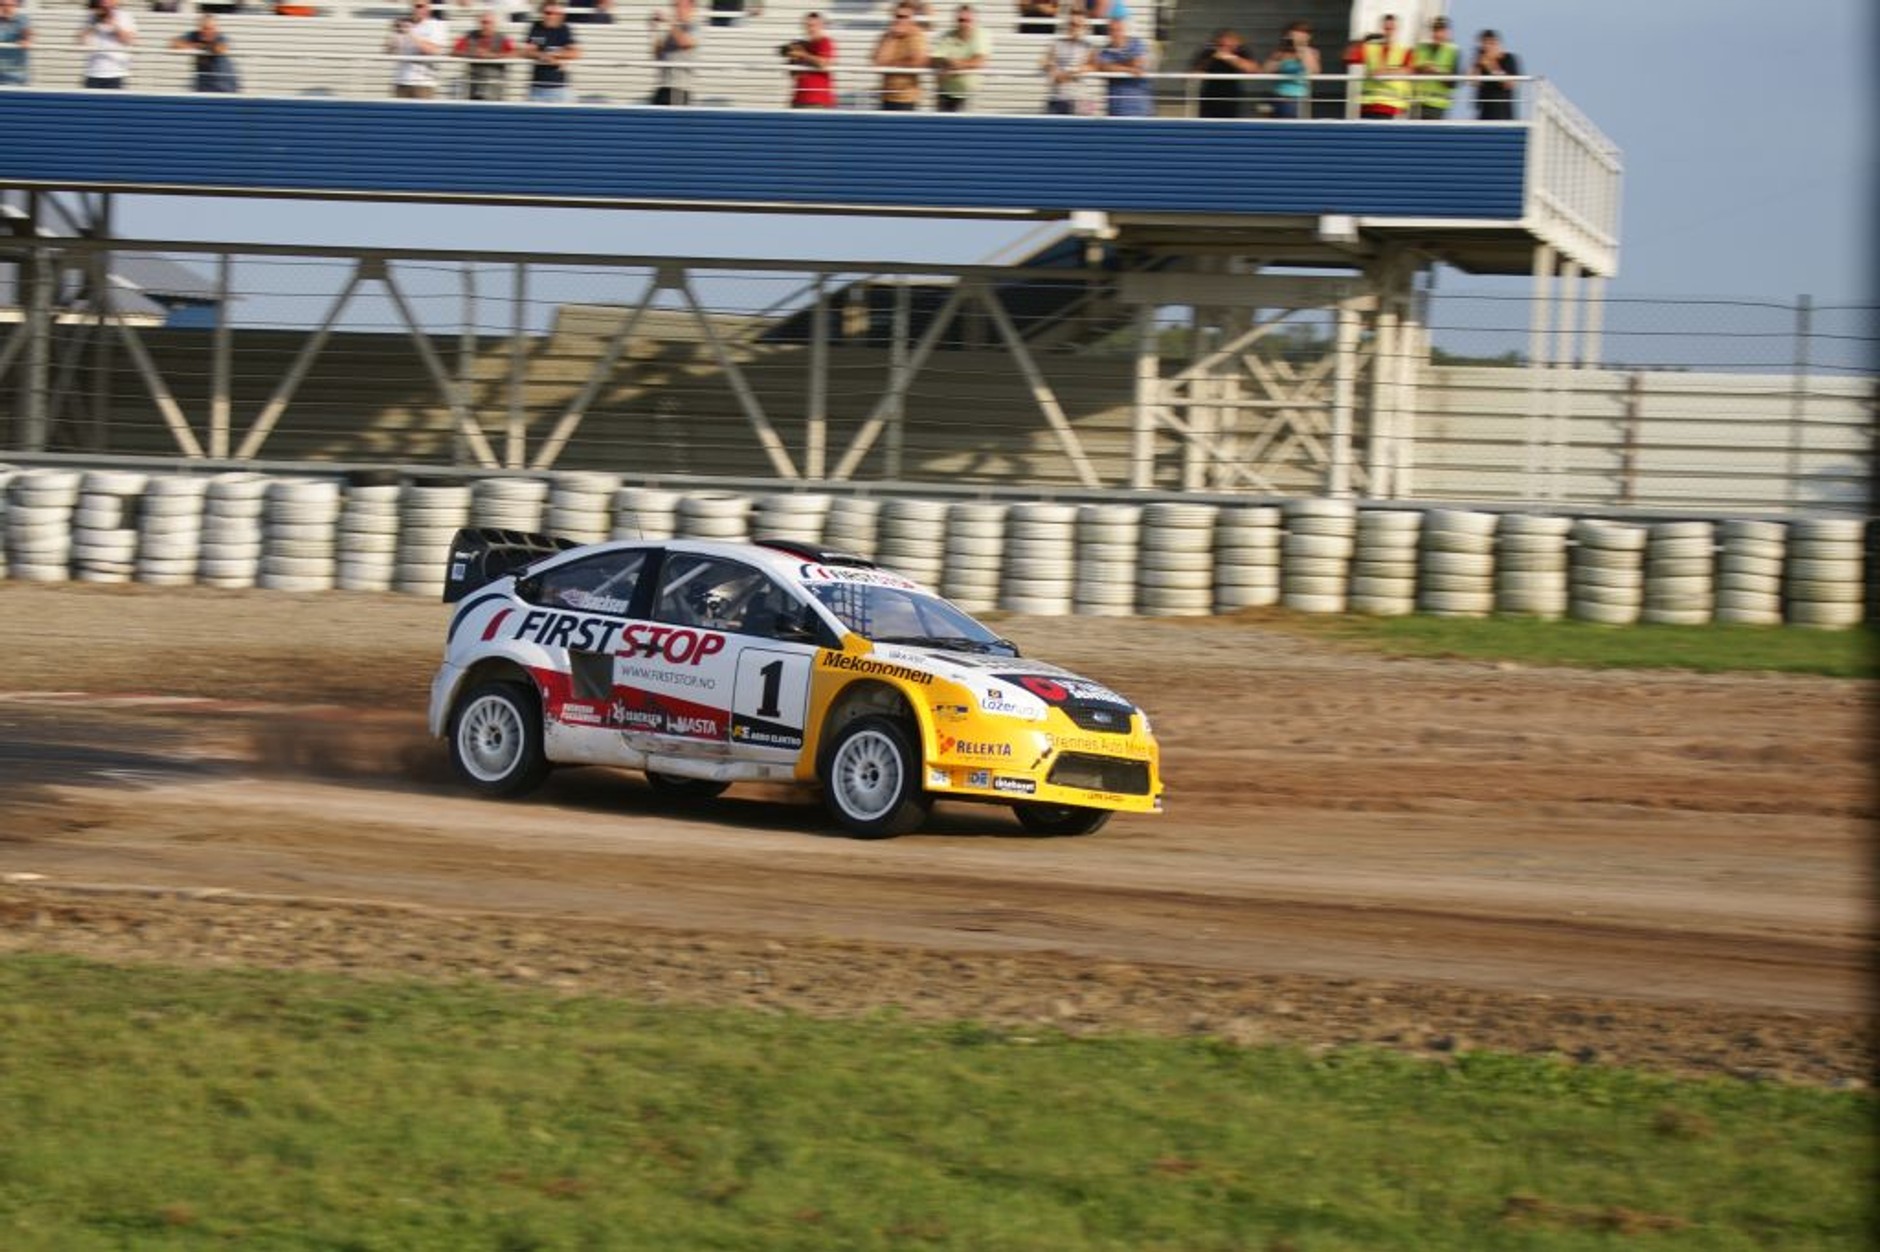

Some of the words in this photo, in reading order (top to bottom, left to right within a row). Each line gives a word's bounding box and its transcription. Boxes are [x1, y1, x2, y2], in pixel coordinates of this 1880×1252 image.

[822, 651, 934, 686] Mekonomen
[756, 659, 784, 718] 1
[956, 739, 1012, 757] RELEKTA
